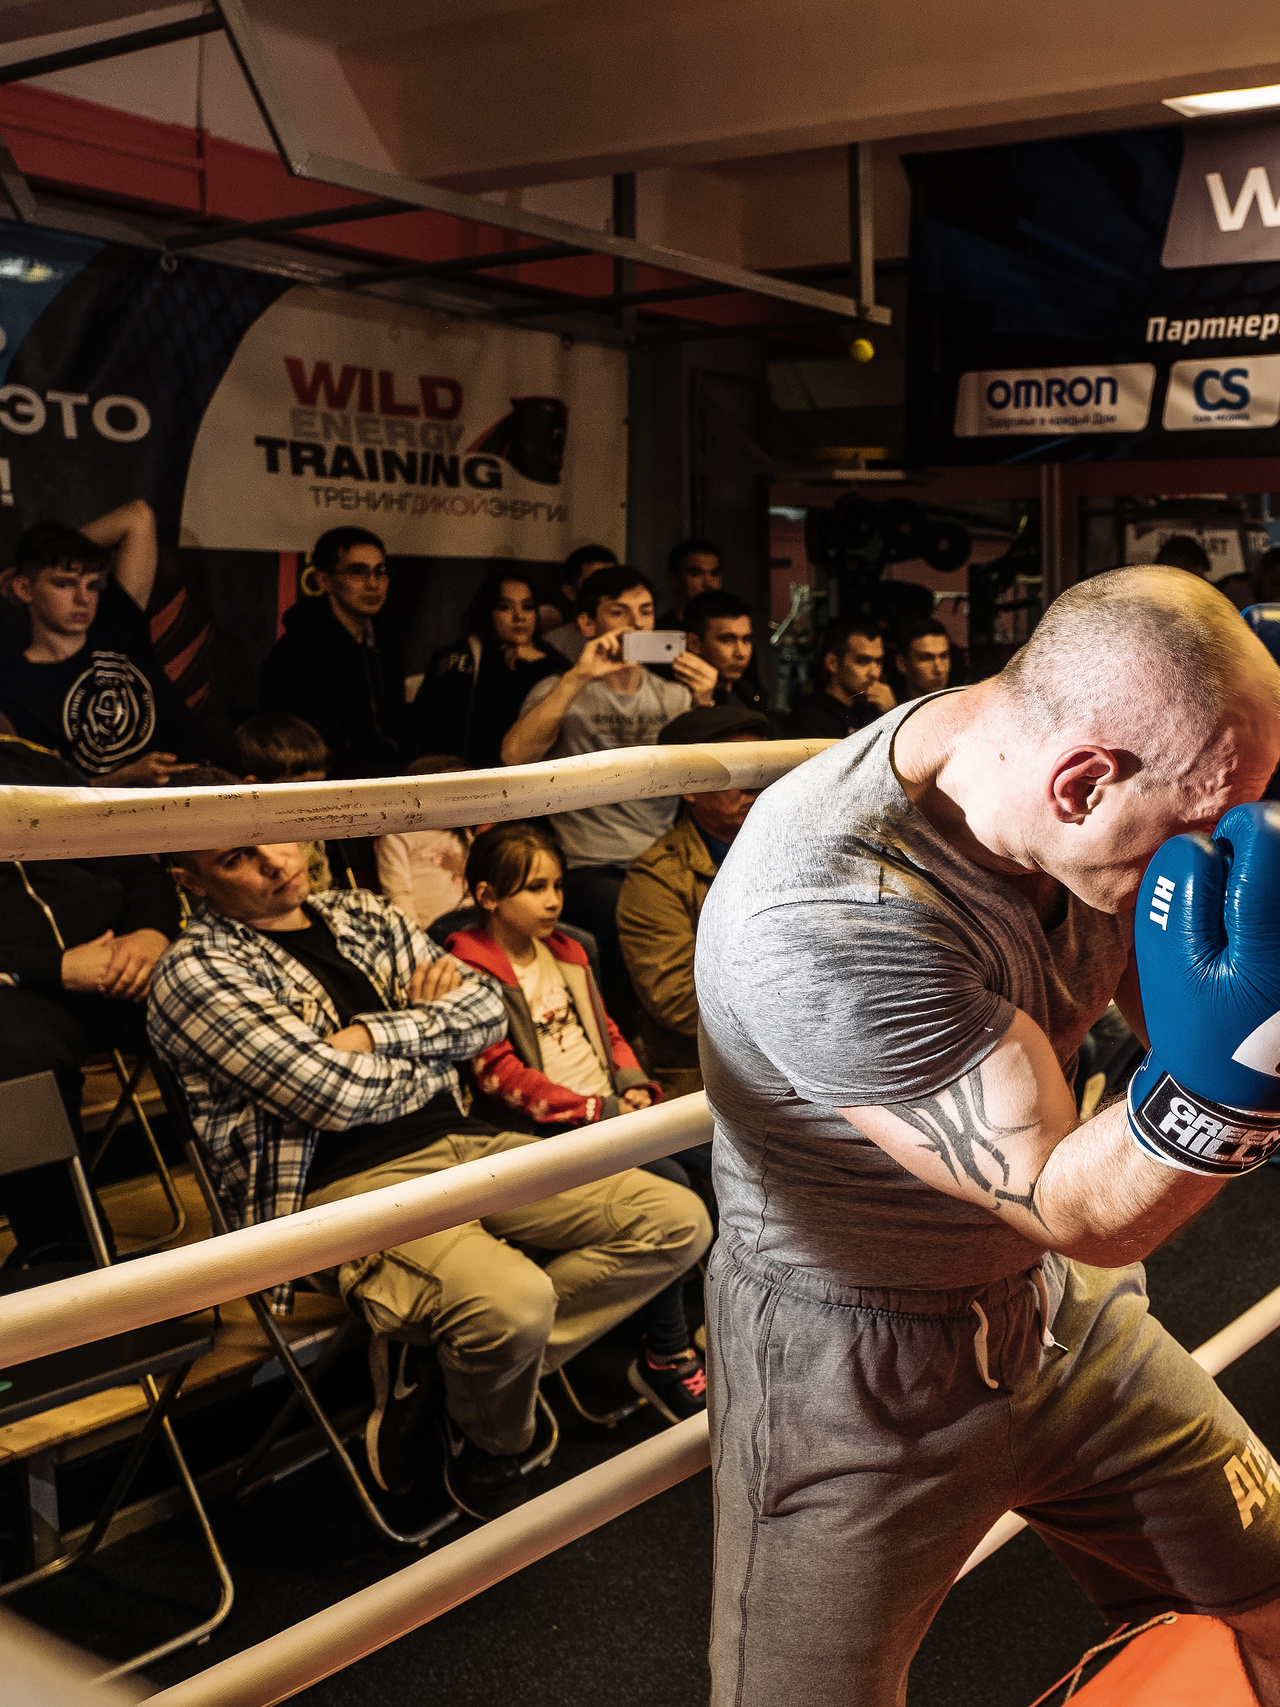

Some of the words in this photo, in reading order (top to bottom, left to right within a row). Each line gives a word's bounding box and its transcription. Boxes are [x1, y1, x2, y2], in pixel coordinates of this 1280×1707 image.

[0, 383, 151, 443] ЭТО
[284, 356, 463, 420] WILD
[1193, 368, 1250, 411] CS
[290, 407, 466, 452] ENERGY
[254, 436, 503, 490] TRAINING
[1149, 875, 1175, 931] HIT
[1159, 1111, 1259, 1163] HILL
